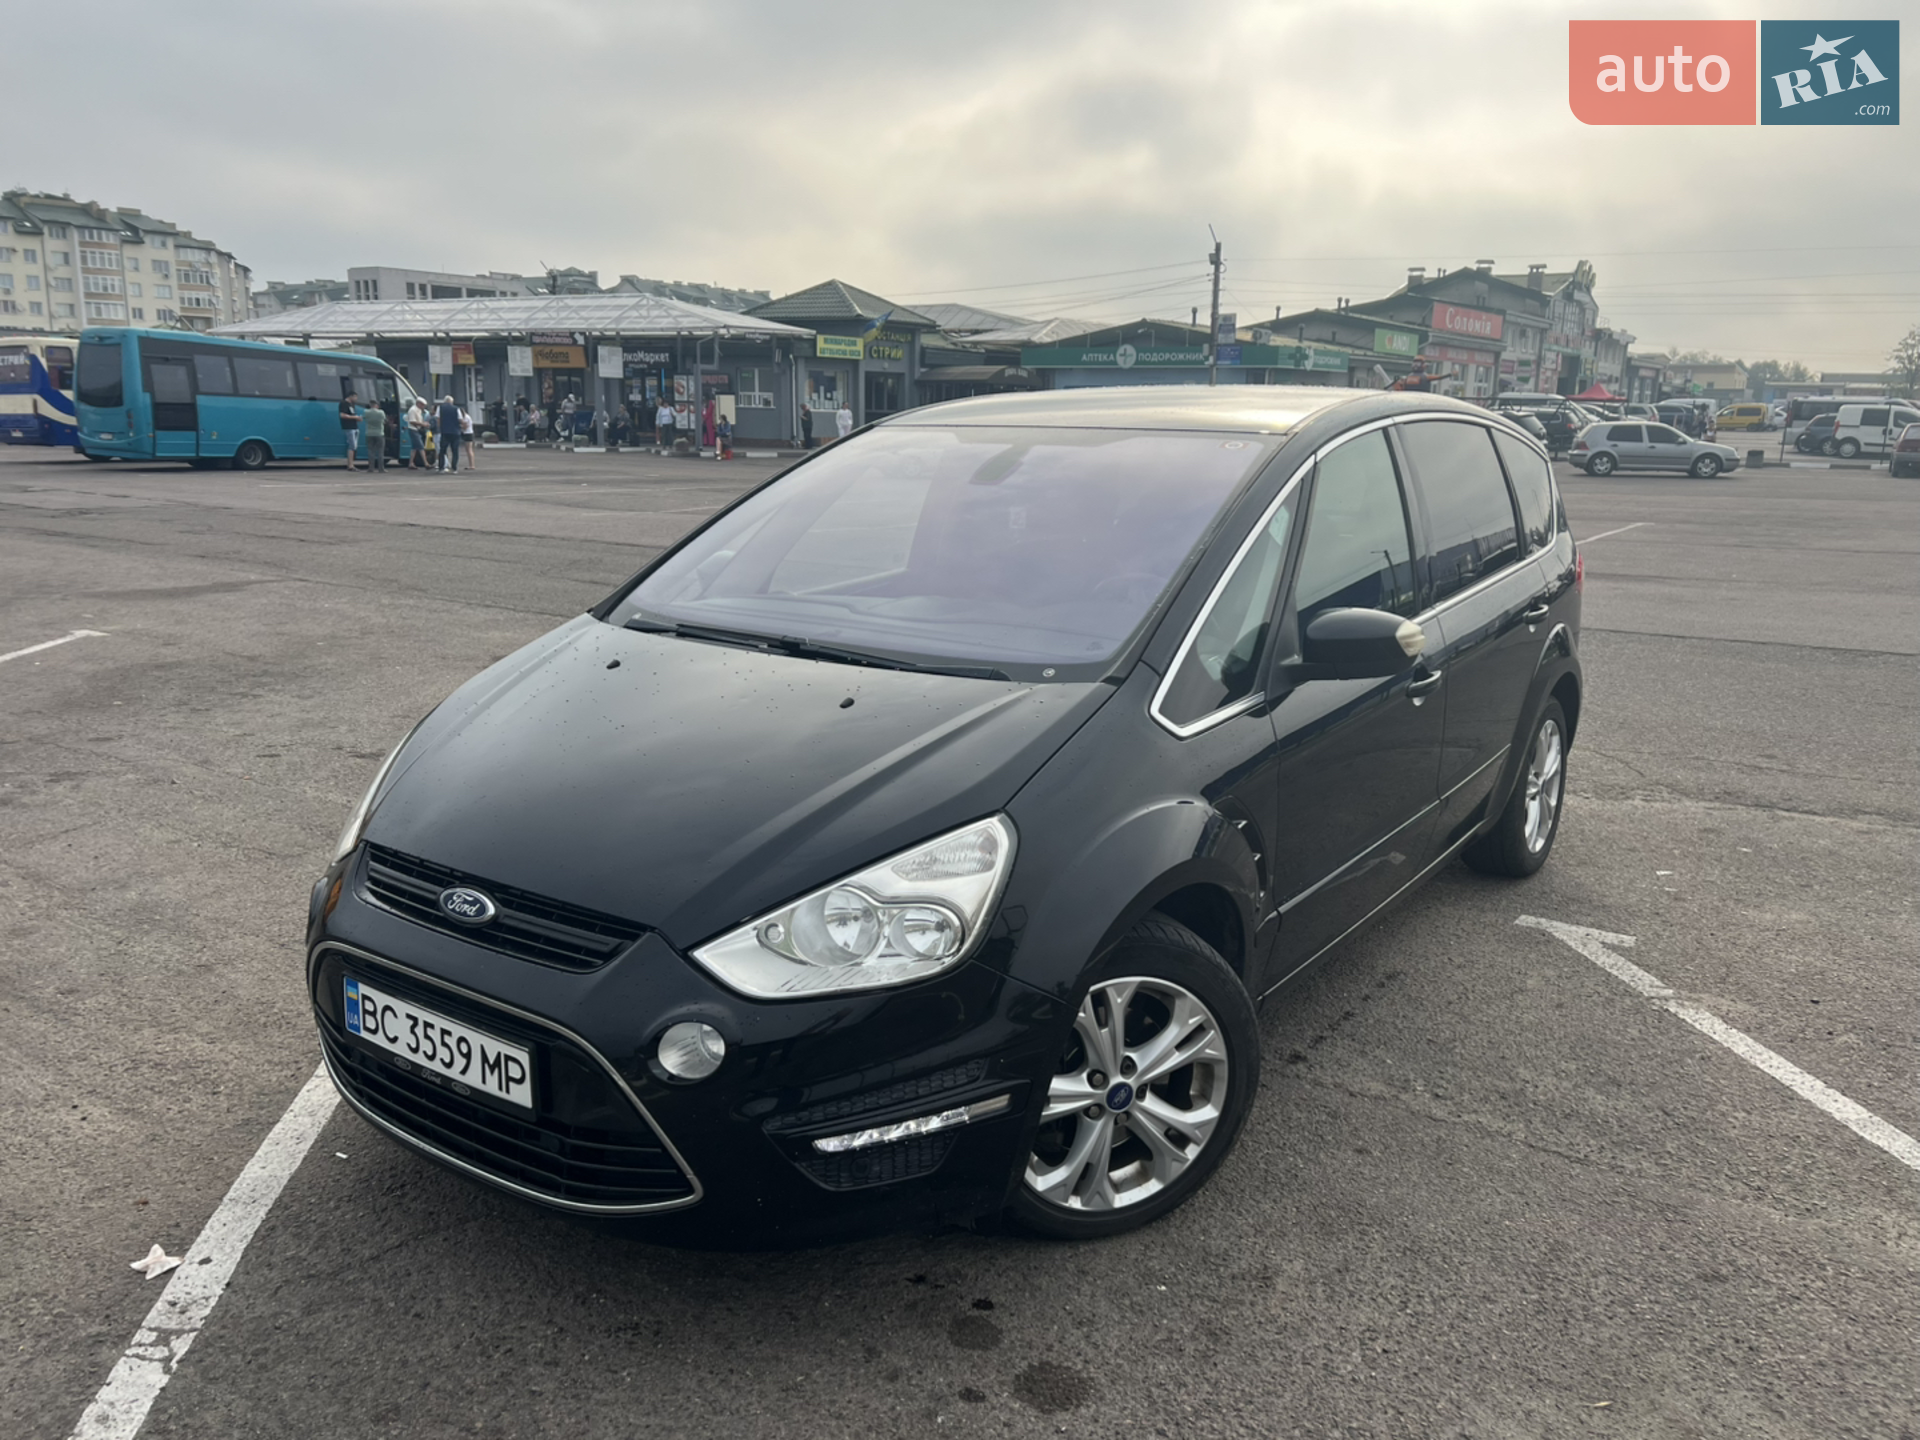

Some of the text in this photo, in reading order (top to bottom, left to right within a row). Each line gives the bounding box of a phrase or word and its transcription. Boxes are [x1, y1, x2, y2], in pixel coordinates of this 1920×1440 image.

[1445, 307, 1493, 335] Соломія
[623, 350, 670, 365] лкоМаркет
[871, 345, 904, 360] СТРИЙ
[1081, 353, 1115, 363] АПТЕКА
[1138, 352, 1205, 364] ПОДОРОЖНИК
[447, 892, 480, 916] Ford
[347, 1013, 360, 1026] UA
[361, 993, 527, 1095] BC 3559 MP
